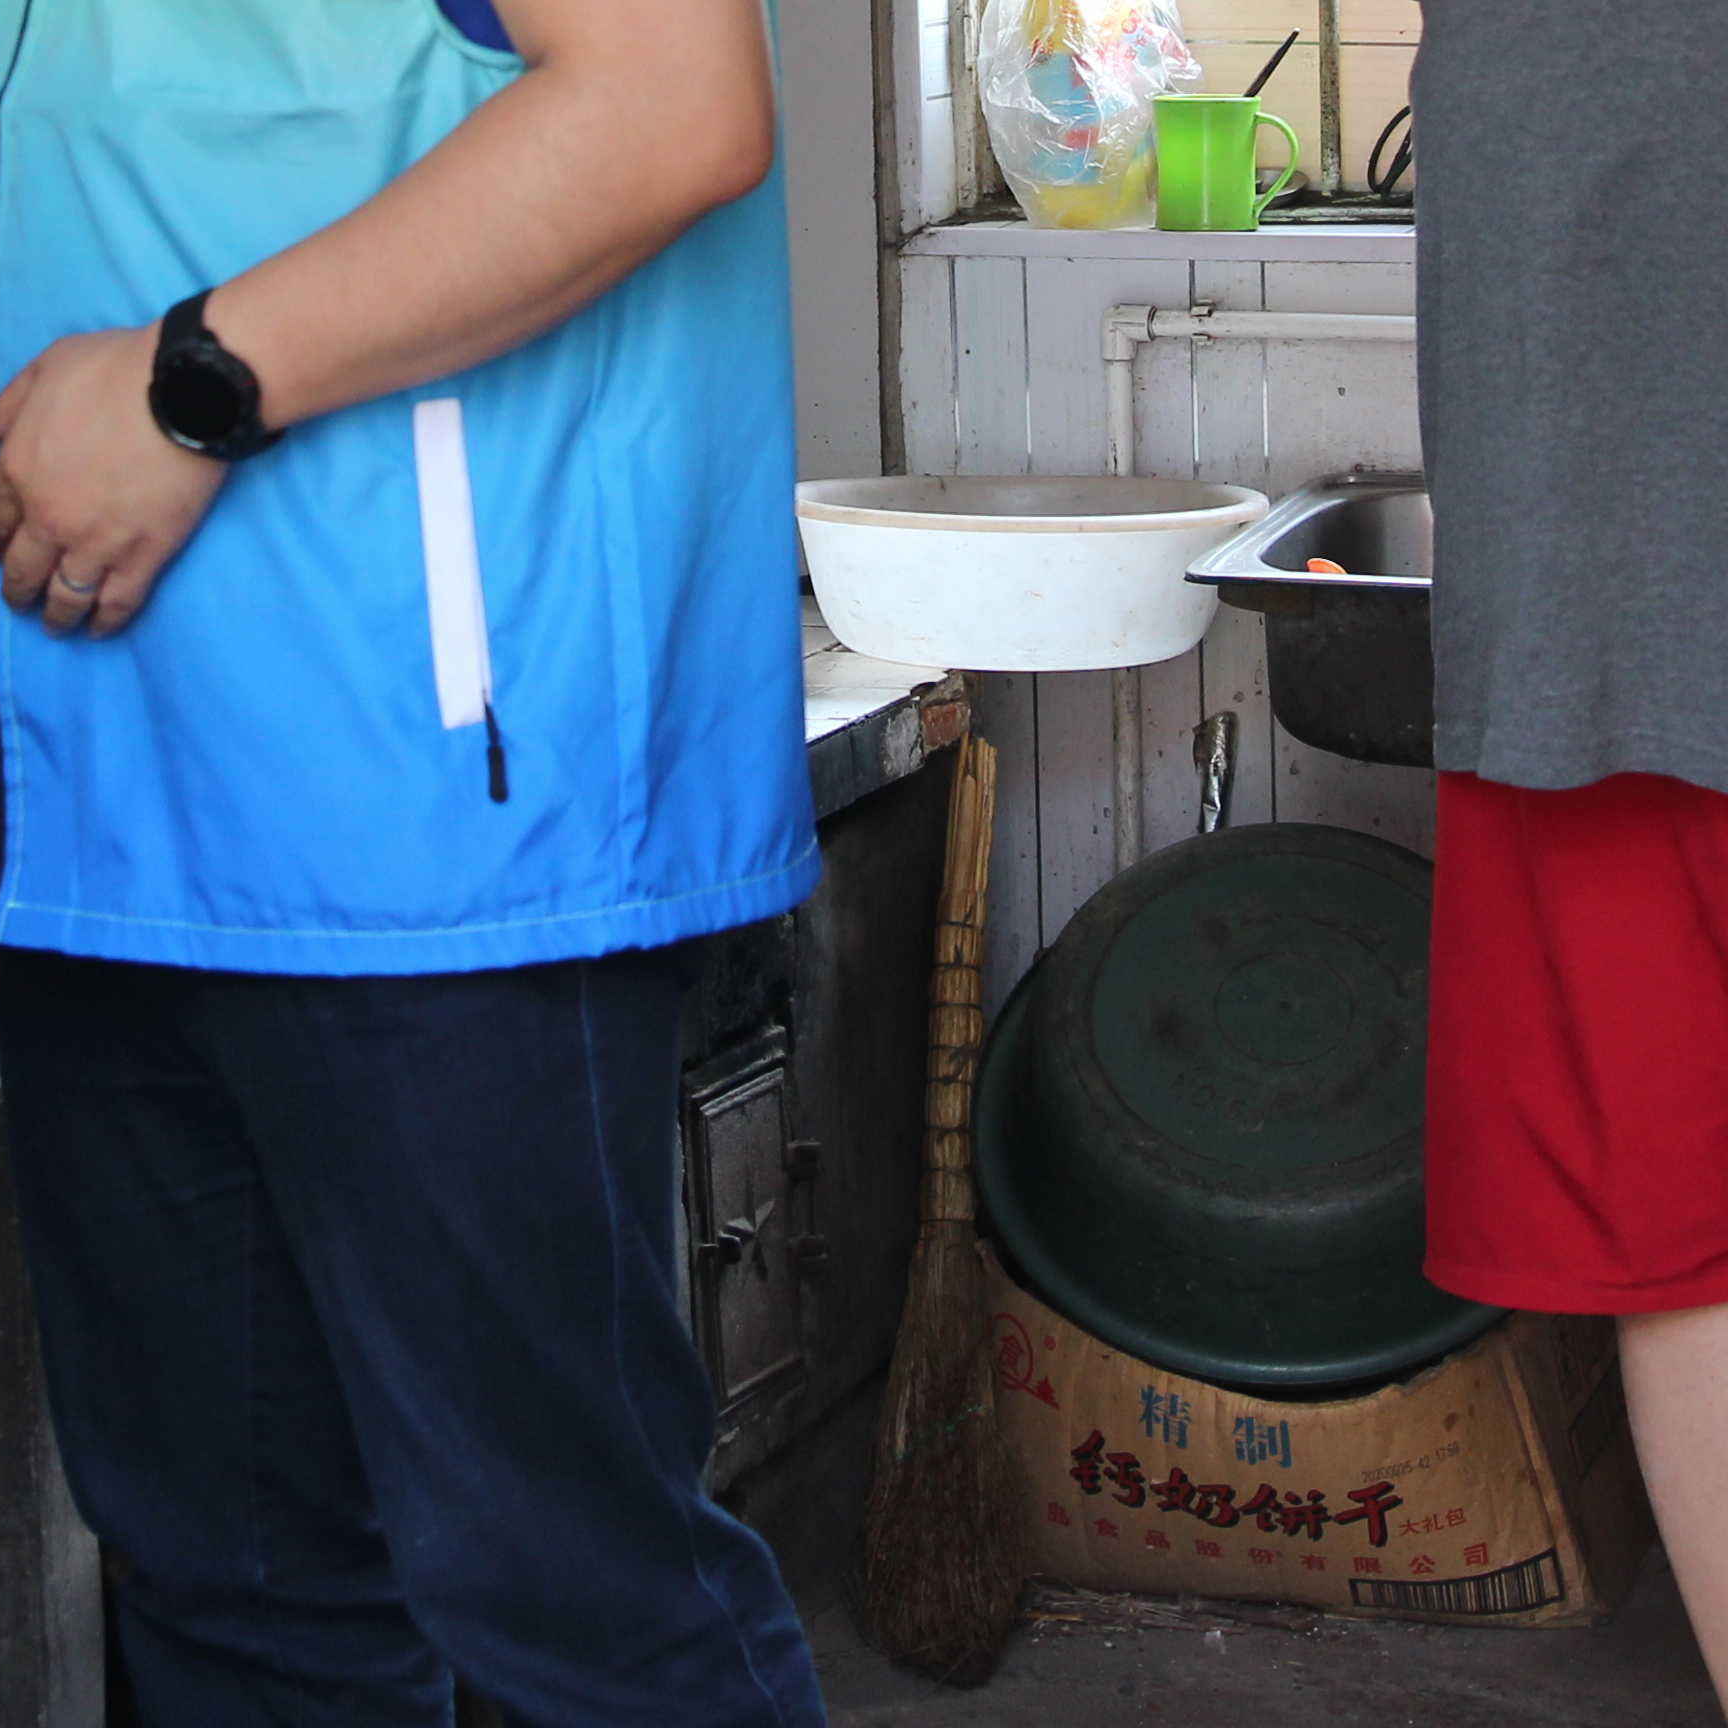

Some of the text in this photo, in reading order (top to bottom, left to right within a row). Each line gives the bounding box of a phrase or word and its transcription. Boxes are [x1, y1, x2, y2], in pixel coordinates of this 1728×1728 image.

[1138, 1383, 1293, 1469] 精制
[1069, 1428, 1404, 1548] 钙奶饼干
[1398, 1507, 1467, 1537] 大礼包
